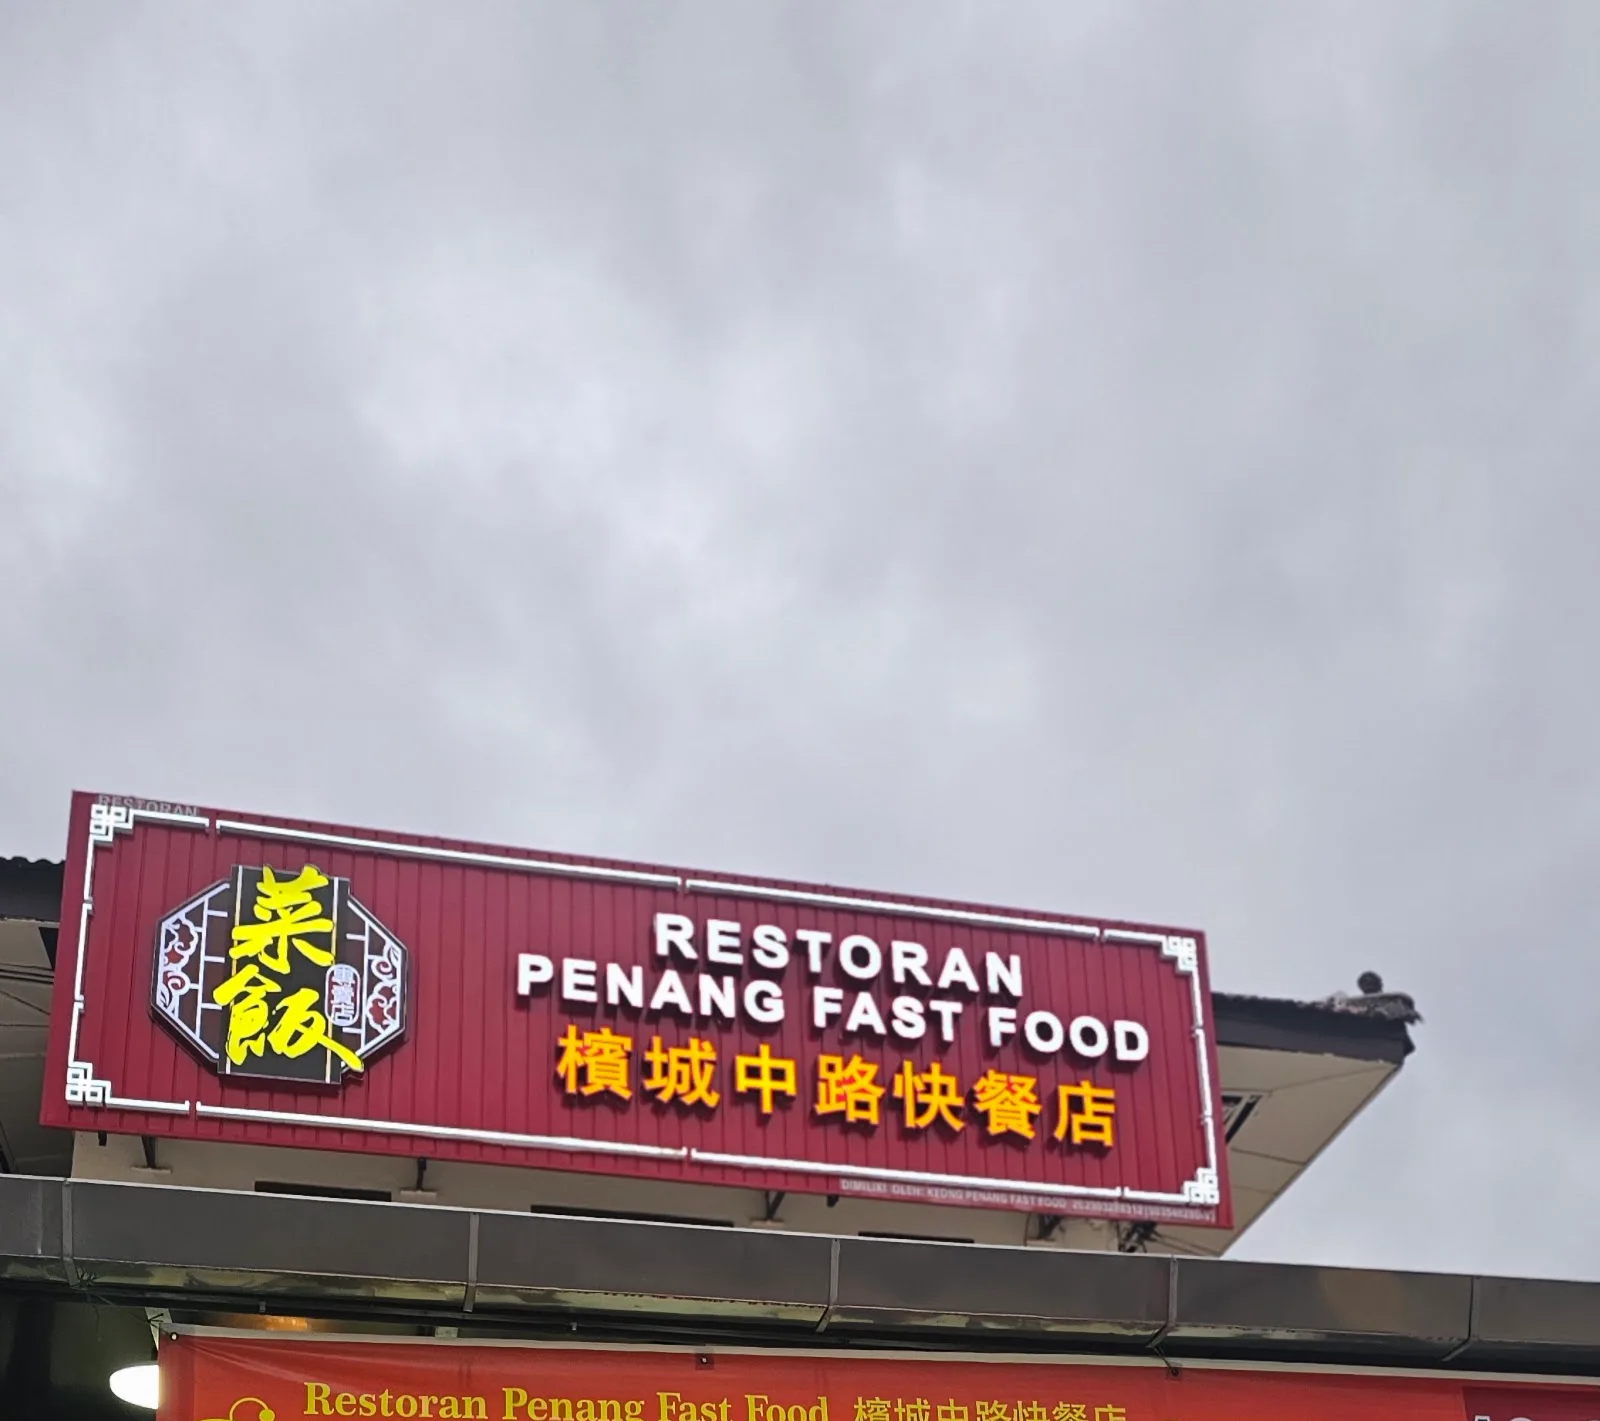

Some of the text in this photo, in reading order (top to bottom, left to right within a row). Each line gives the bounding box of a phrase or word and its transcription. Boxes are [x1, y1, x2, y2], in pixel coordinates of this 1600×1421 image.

[98, 794, 198, 816] RESTORAN
[213, 863, 365, 1072] 菜飯
[654, 912, 1023, 997] RESTORAN
[516, 953, 1150, 1062] PENANG FAST FOOD
[556, 1023, 1116, 1147] 檳城中路快餐店
[927, 1187, 964, 1201] KEONG
[965, 1190, 1008, 1204] PENANG
[1009, 1194, 1036, 1206] FAST
[1038, 1196, 1067, 1209] FOOD
[303, 1381, 489, 1420] Restoran
